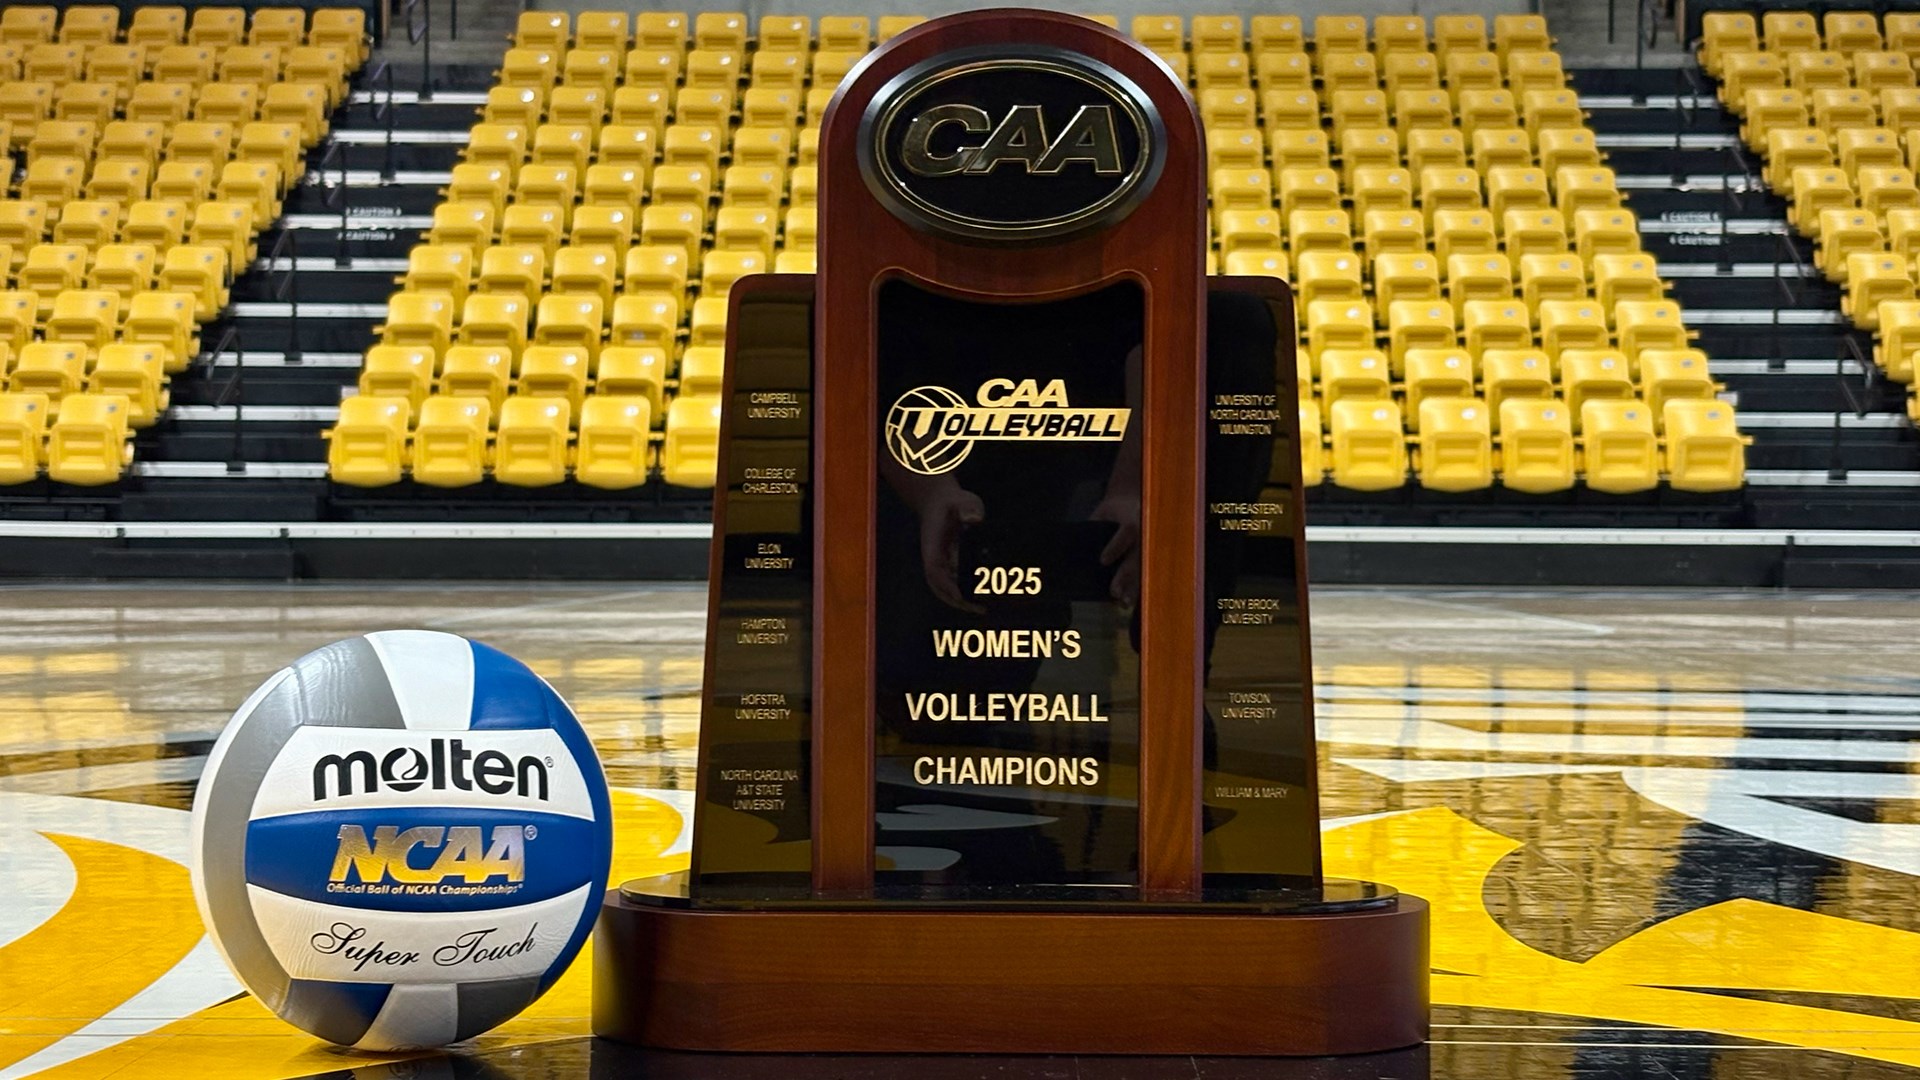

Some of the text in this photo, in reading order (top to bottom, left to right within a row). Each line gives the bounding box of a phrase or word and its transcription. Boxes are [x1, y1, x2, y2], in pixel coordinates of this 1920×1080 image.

[902, 103, 1122, 178] CAA
[750, 392, 799, 404] CAMPBELL
[976, 378, 1069, 408] CAA
[1215, 394, 1277, 406] UNIVERSITY OF
[747, 407, 802, 418] UNIVERSITY
[1210, 409, 1280, 420] NORTH CAROLINA
[900, 411, 1122, 454] VOLLEYBALL
[1219, 424, 1272, 435] WILMINGTON
[744, 468, 797, 479] COLLEGE OF
[743, 482, 799, 494] CHARLESTON
[1210, 503, 1284, 514] NORTHEASTERN
[1220, 519, 1274, 530] UNIVERSITY
[757, 543, 782, 554] ELON
[744, 558, 794, 569] UNIVERSITY
[973, 566, 1042, 595] 2025
[1217, 598, 1280, 610] STONY BROOK
[740, 618, 786, 630] HAMPTON
[1222, 613, 1274, 624] UNIVERSITY
[736, 633, 790, 644] UNIVERSITY
[932, 630, 1082, 658] WOMEN’S
[740, 694, 786, 705] HOFSTRA
[1228, 692, 1271, 704] TOWSON
[905, 693, 1109, 722] VOLLEYBALL
[1222, 708, 1277, 718] UNIVERSITY
[735, 709, 791, 720] UNIVERSITY
[720, 770, 798, 781] NORTH CAROLINA
[913, 757, 1099, 785] CHAMPIONS
[736, 785, 783, 796] A&T STATE
[1214, 786, 1288, 798] WILLIAM & MARY
[733, 799, 786, 810] UNIVERSITY
[326, 882, 365, 894] Official
[367, 883, 390, 894] Ball
[391, 883, 404, 894] of
[406, 884, 437, 895] NCAA
[311, 922, 538, 971] Super Touch
